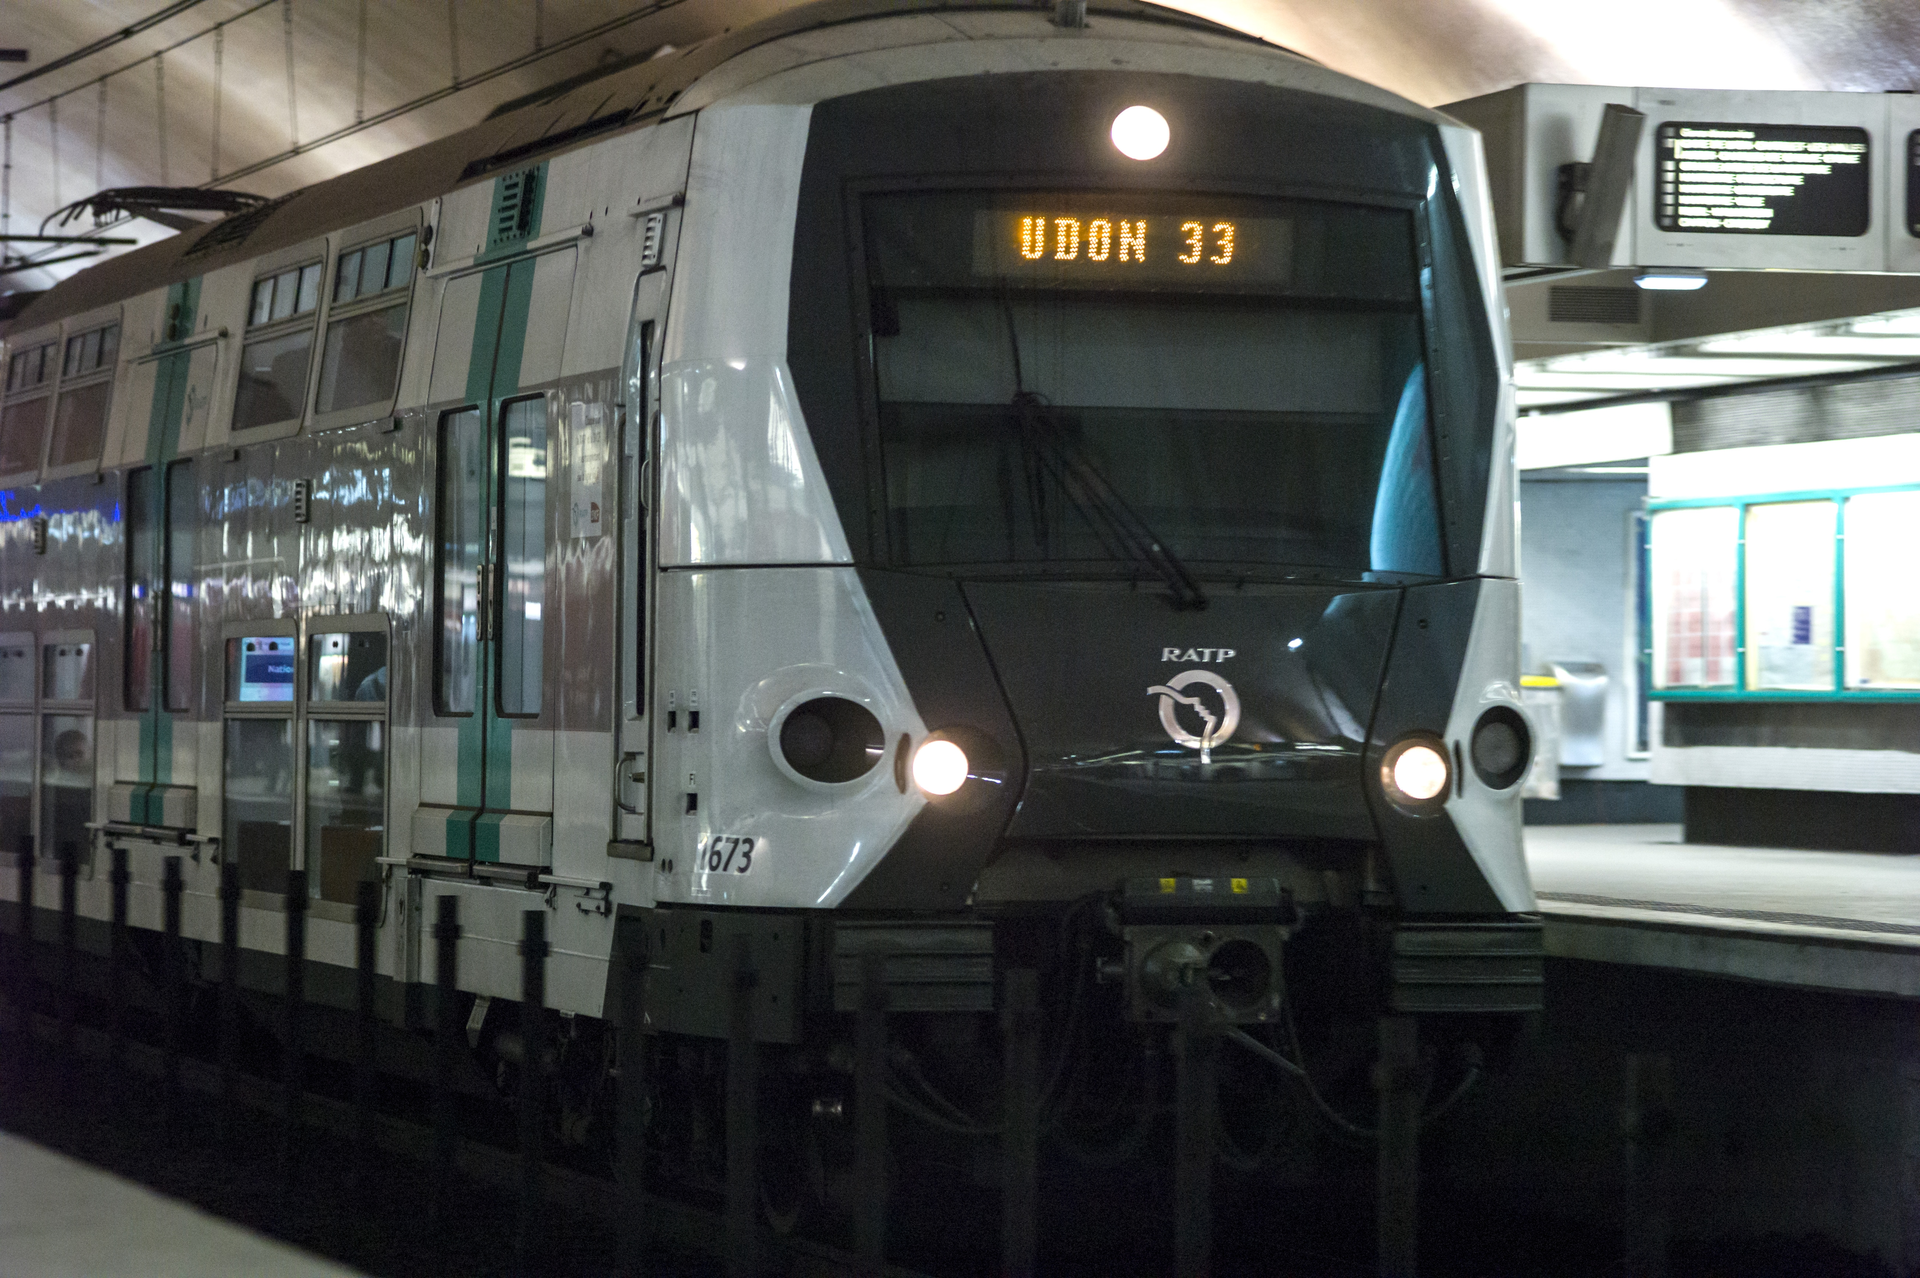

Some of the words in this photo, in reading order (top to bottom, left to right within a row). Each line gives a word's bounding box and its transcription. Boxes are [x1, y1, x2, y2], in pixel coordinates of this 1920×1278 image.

[1021, 216, 1146, 262] UDON
[1179, 221, 1235, 264] 33
[1161, 647, 1237, 662] RATP
[699, 835, 755, 873] 1673
